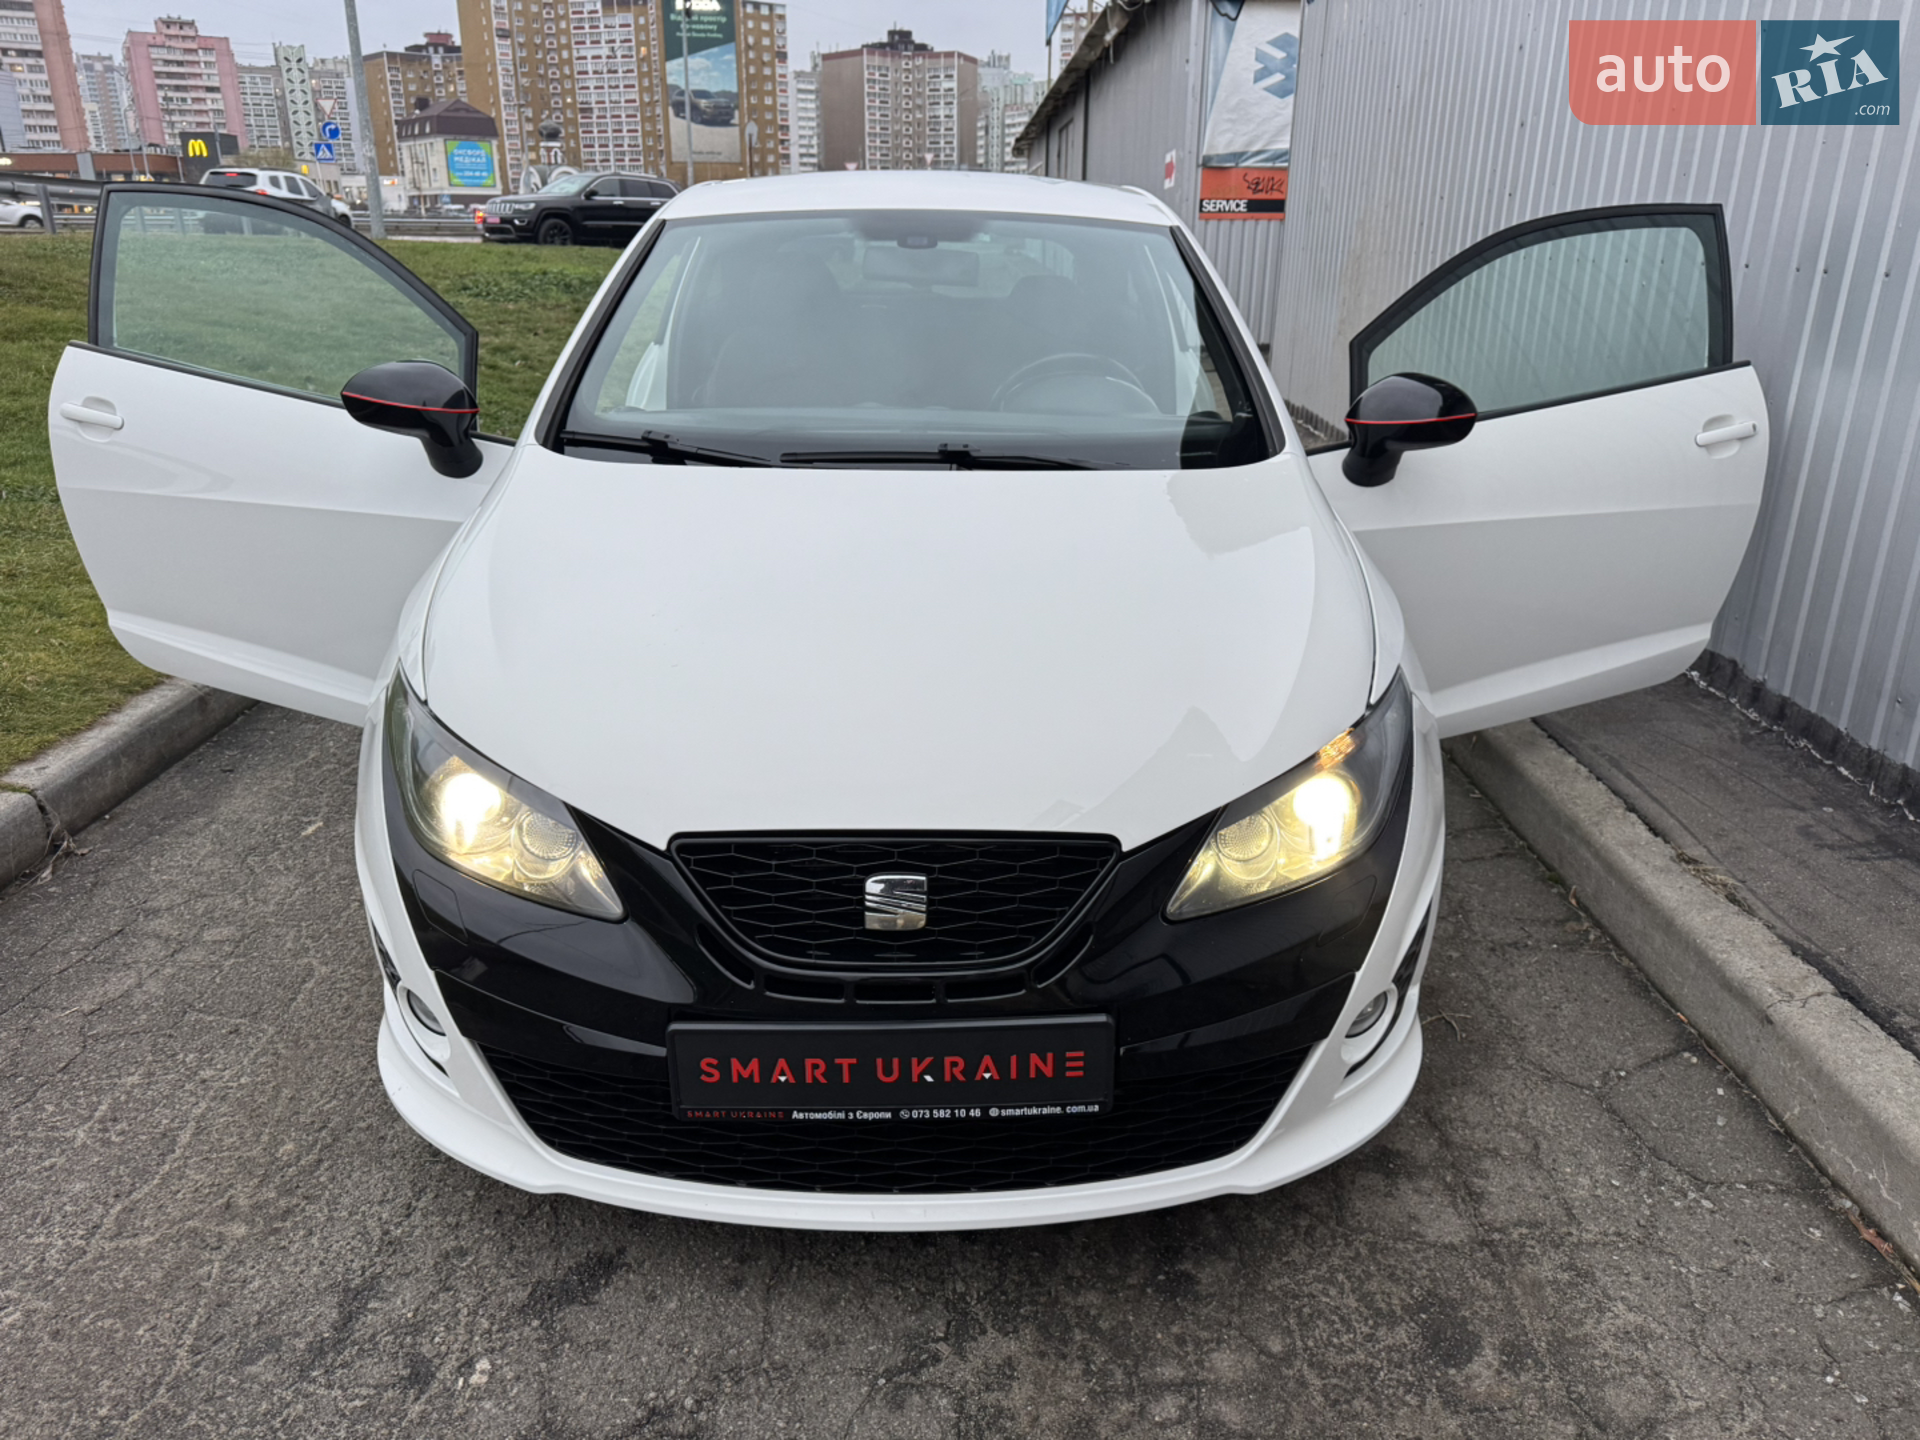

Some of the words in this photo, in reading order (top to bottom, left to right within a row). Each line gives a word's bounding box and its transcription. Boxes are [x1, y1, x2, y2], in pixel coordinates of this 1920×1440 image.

[1202, 199, 1248, 212] SERVICE
[700, 1057, 857, 1083] SMART
[876, 1051, 1085, 1083] UKRAINE
[687, 1110, 726, 1119] SMART
[731, 1110, 784, 1119] UKRAINE
[792, 1110, 846, 1120] Автомобілі
[848, 1112, 854, 1120] з
[856, 1110, 892, 1121] Європи
[911, 1109, 930, 1118] 073
[933, 1109, 951, 1118] 582
[954, 1109, 966, 1118] 10
[969, 1108, 981, 1117] 46
